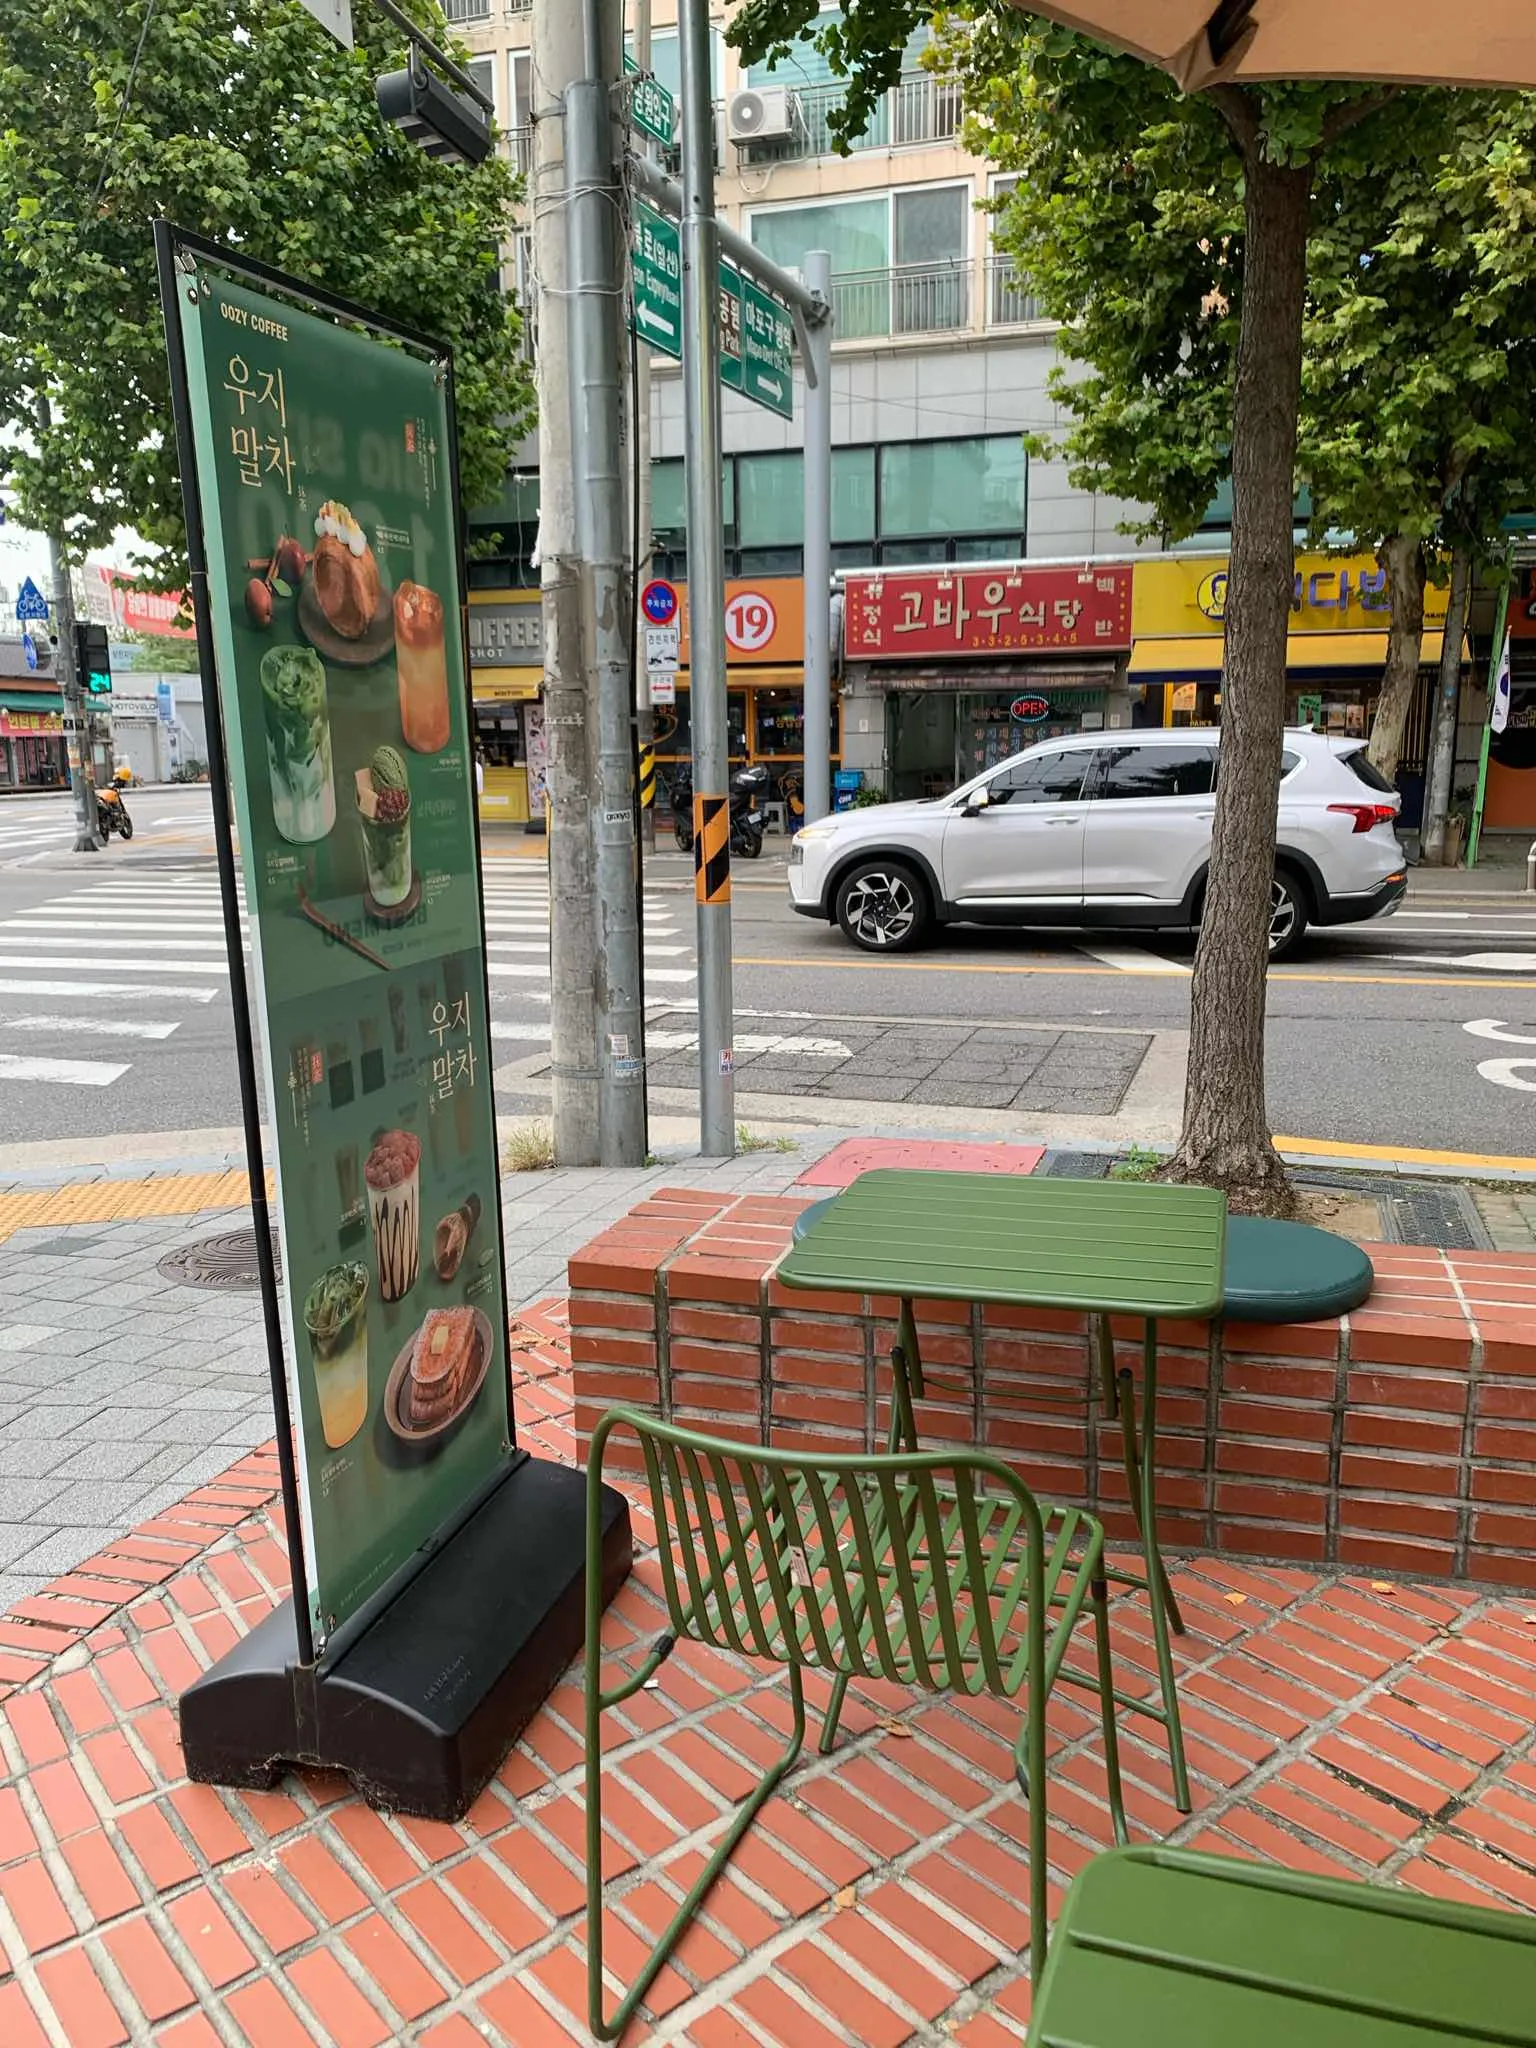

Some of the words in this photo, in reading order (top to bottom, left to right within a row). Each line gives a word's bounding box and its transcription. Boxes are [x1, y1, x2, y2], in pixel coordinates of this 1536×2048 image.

[626, 69, 669, 136] 공원입구
[220, 302, 249, 327] OOZY
[250, 313, 288, 342] COFFEE
[223, 353, 288, 428] 우지
[230, 426, 297, 496] 말차
[646, 599, 673, 609] 주차금지
[730, 605, 768, 640] 19
[892, 576, 1084, 640] 고바우식당
[470, 616, 541, 647] OFFEE
[89, 671, 111, 693] 24
[1012, 702, 1048, 716] OPEN
[428, 991, 472, 1047] 우지
[432, 1042, 478, 1100] 말차
